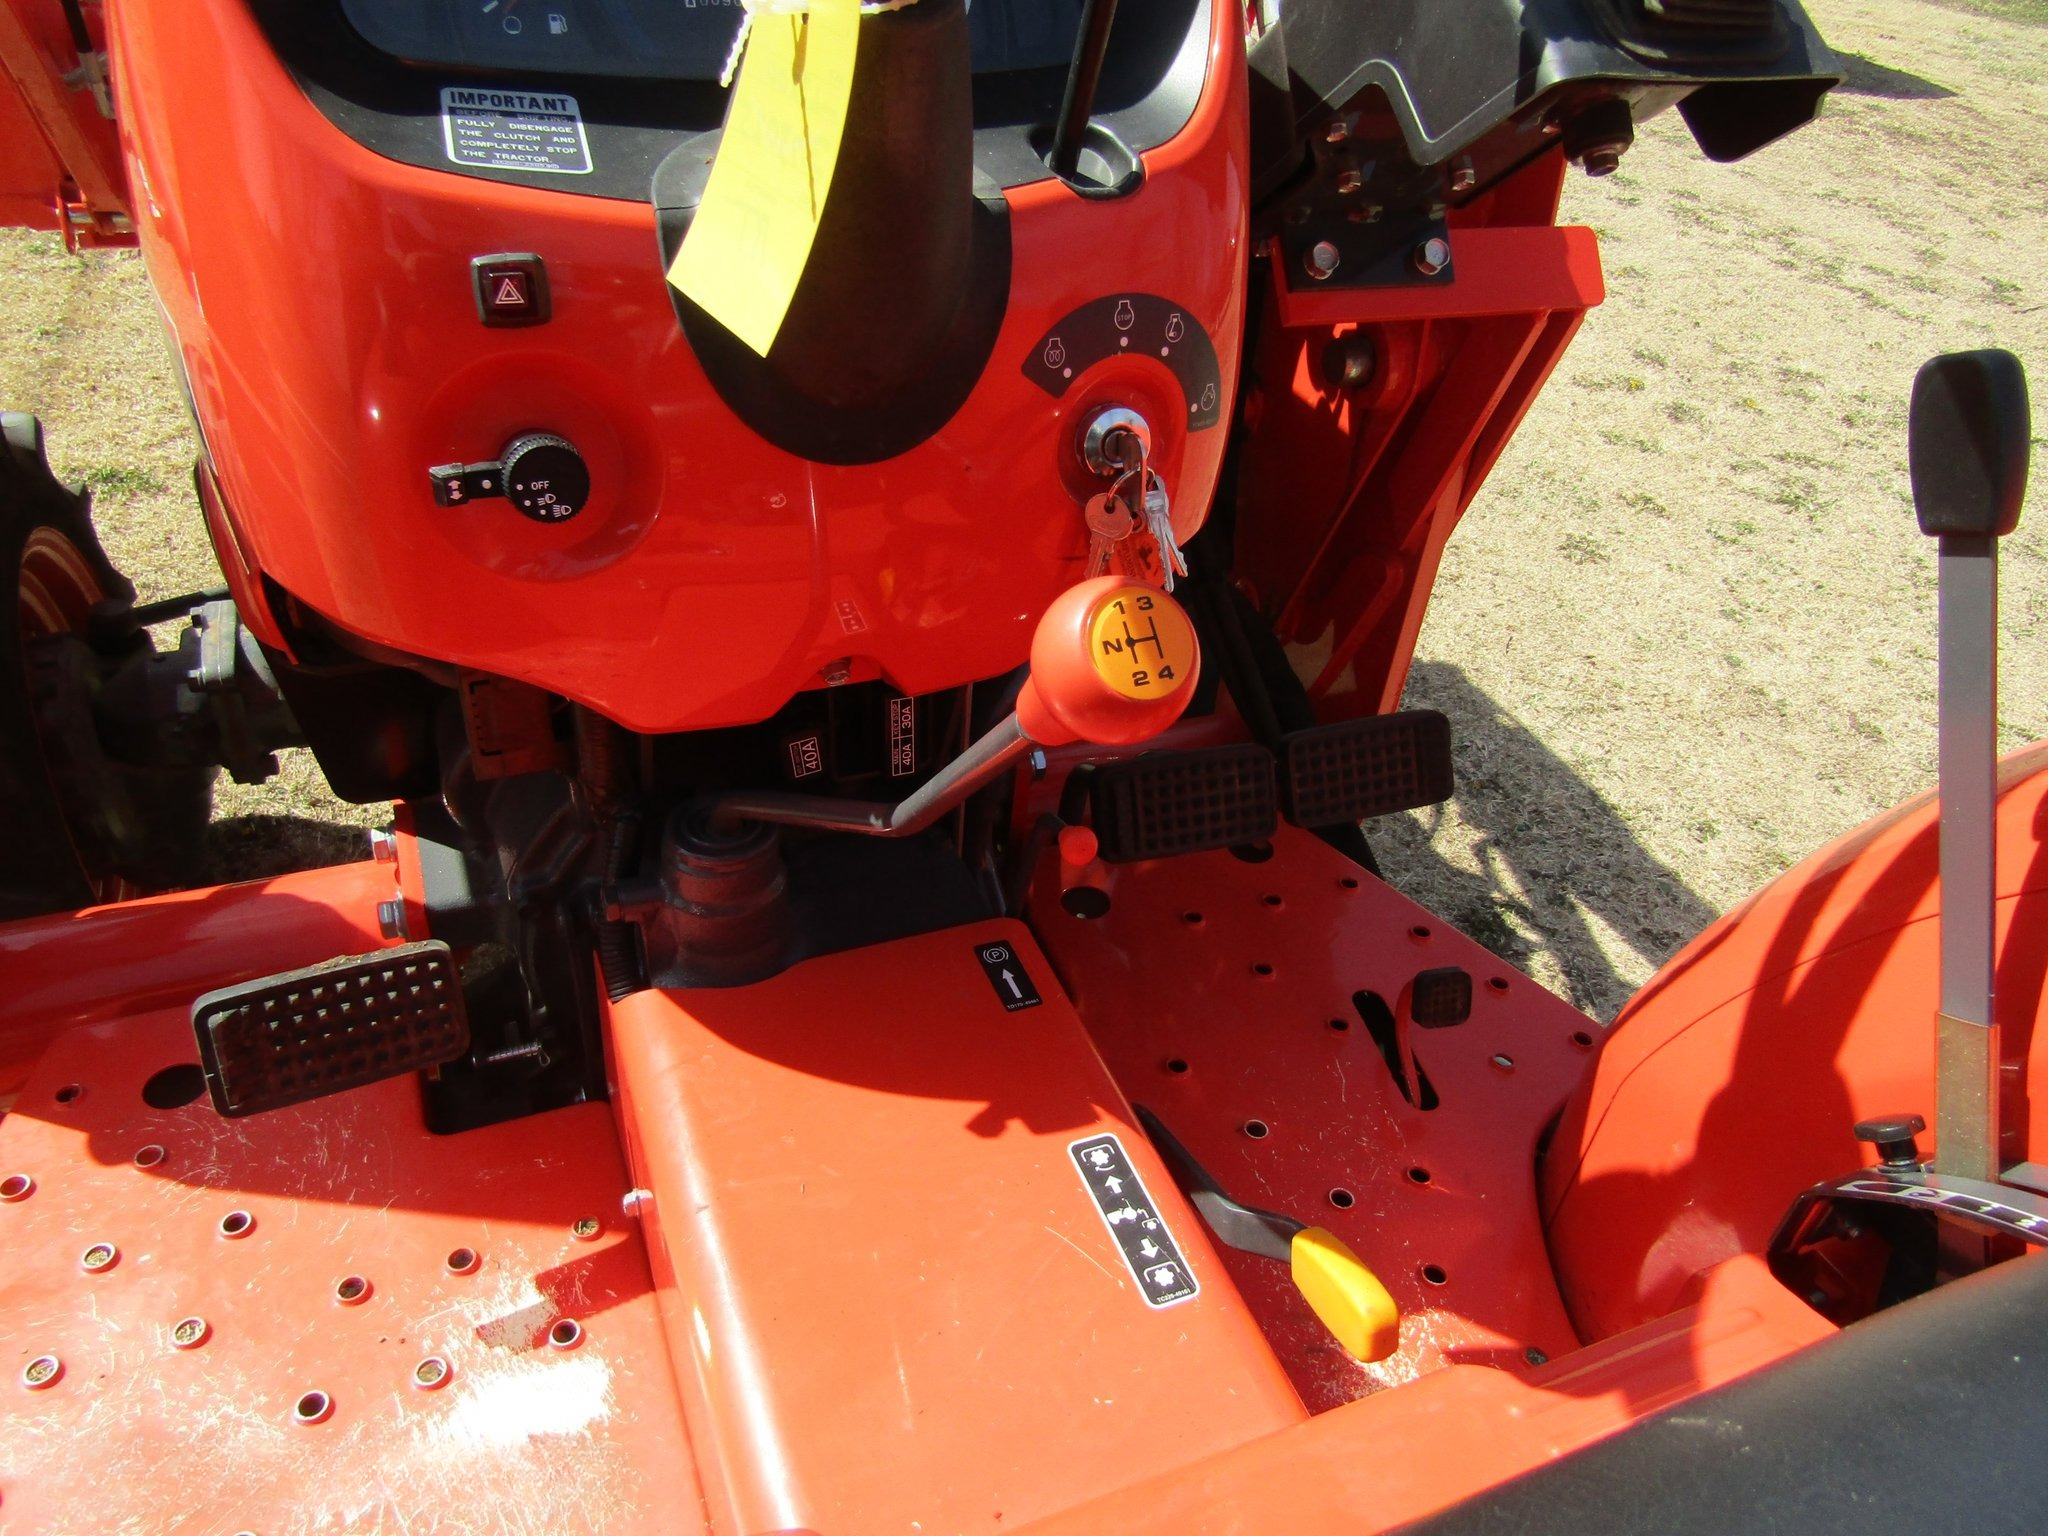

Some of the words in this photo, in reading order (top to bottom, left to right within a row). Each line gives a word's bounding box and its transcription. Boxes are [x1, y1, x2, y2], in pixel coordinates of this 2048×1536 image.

[450, 91, 568, 112] IMPORTANT
[457, 118, 496, 128] FULLY
[508, 122, 574, 134] DISENGAGE
[458, 129, 483, 137] THE
[494, 132, 541, 142] CLUTCH
[552, 136, 576, 144] AND
[460, 139, 540, 152] COMPLETELY
[546, 146, 577, 154] STOP
[462, 149, 487, 158] THE
[495, 152, 553, 163] TRACTOR.
[530, 480, 550, 491] OFF
[1112, 600, 1126, 615] 1
[1136, 596, 1154, 611] 3
[1102, 638, 1123, 655] N
[1132, 670, 1150, 687] 2
[1158, 665, 1175, 680] 4
[901, 705, 912, 730] 30A
[802, 740, 818, 769] 40A
[901, 743, 912, 766] 40A
